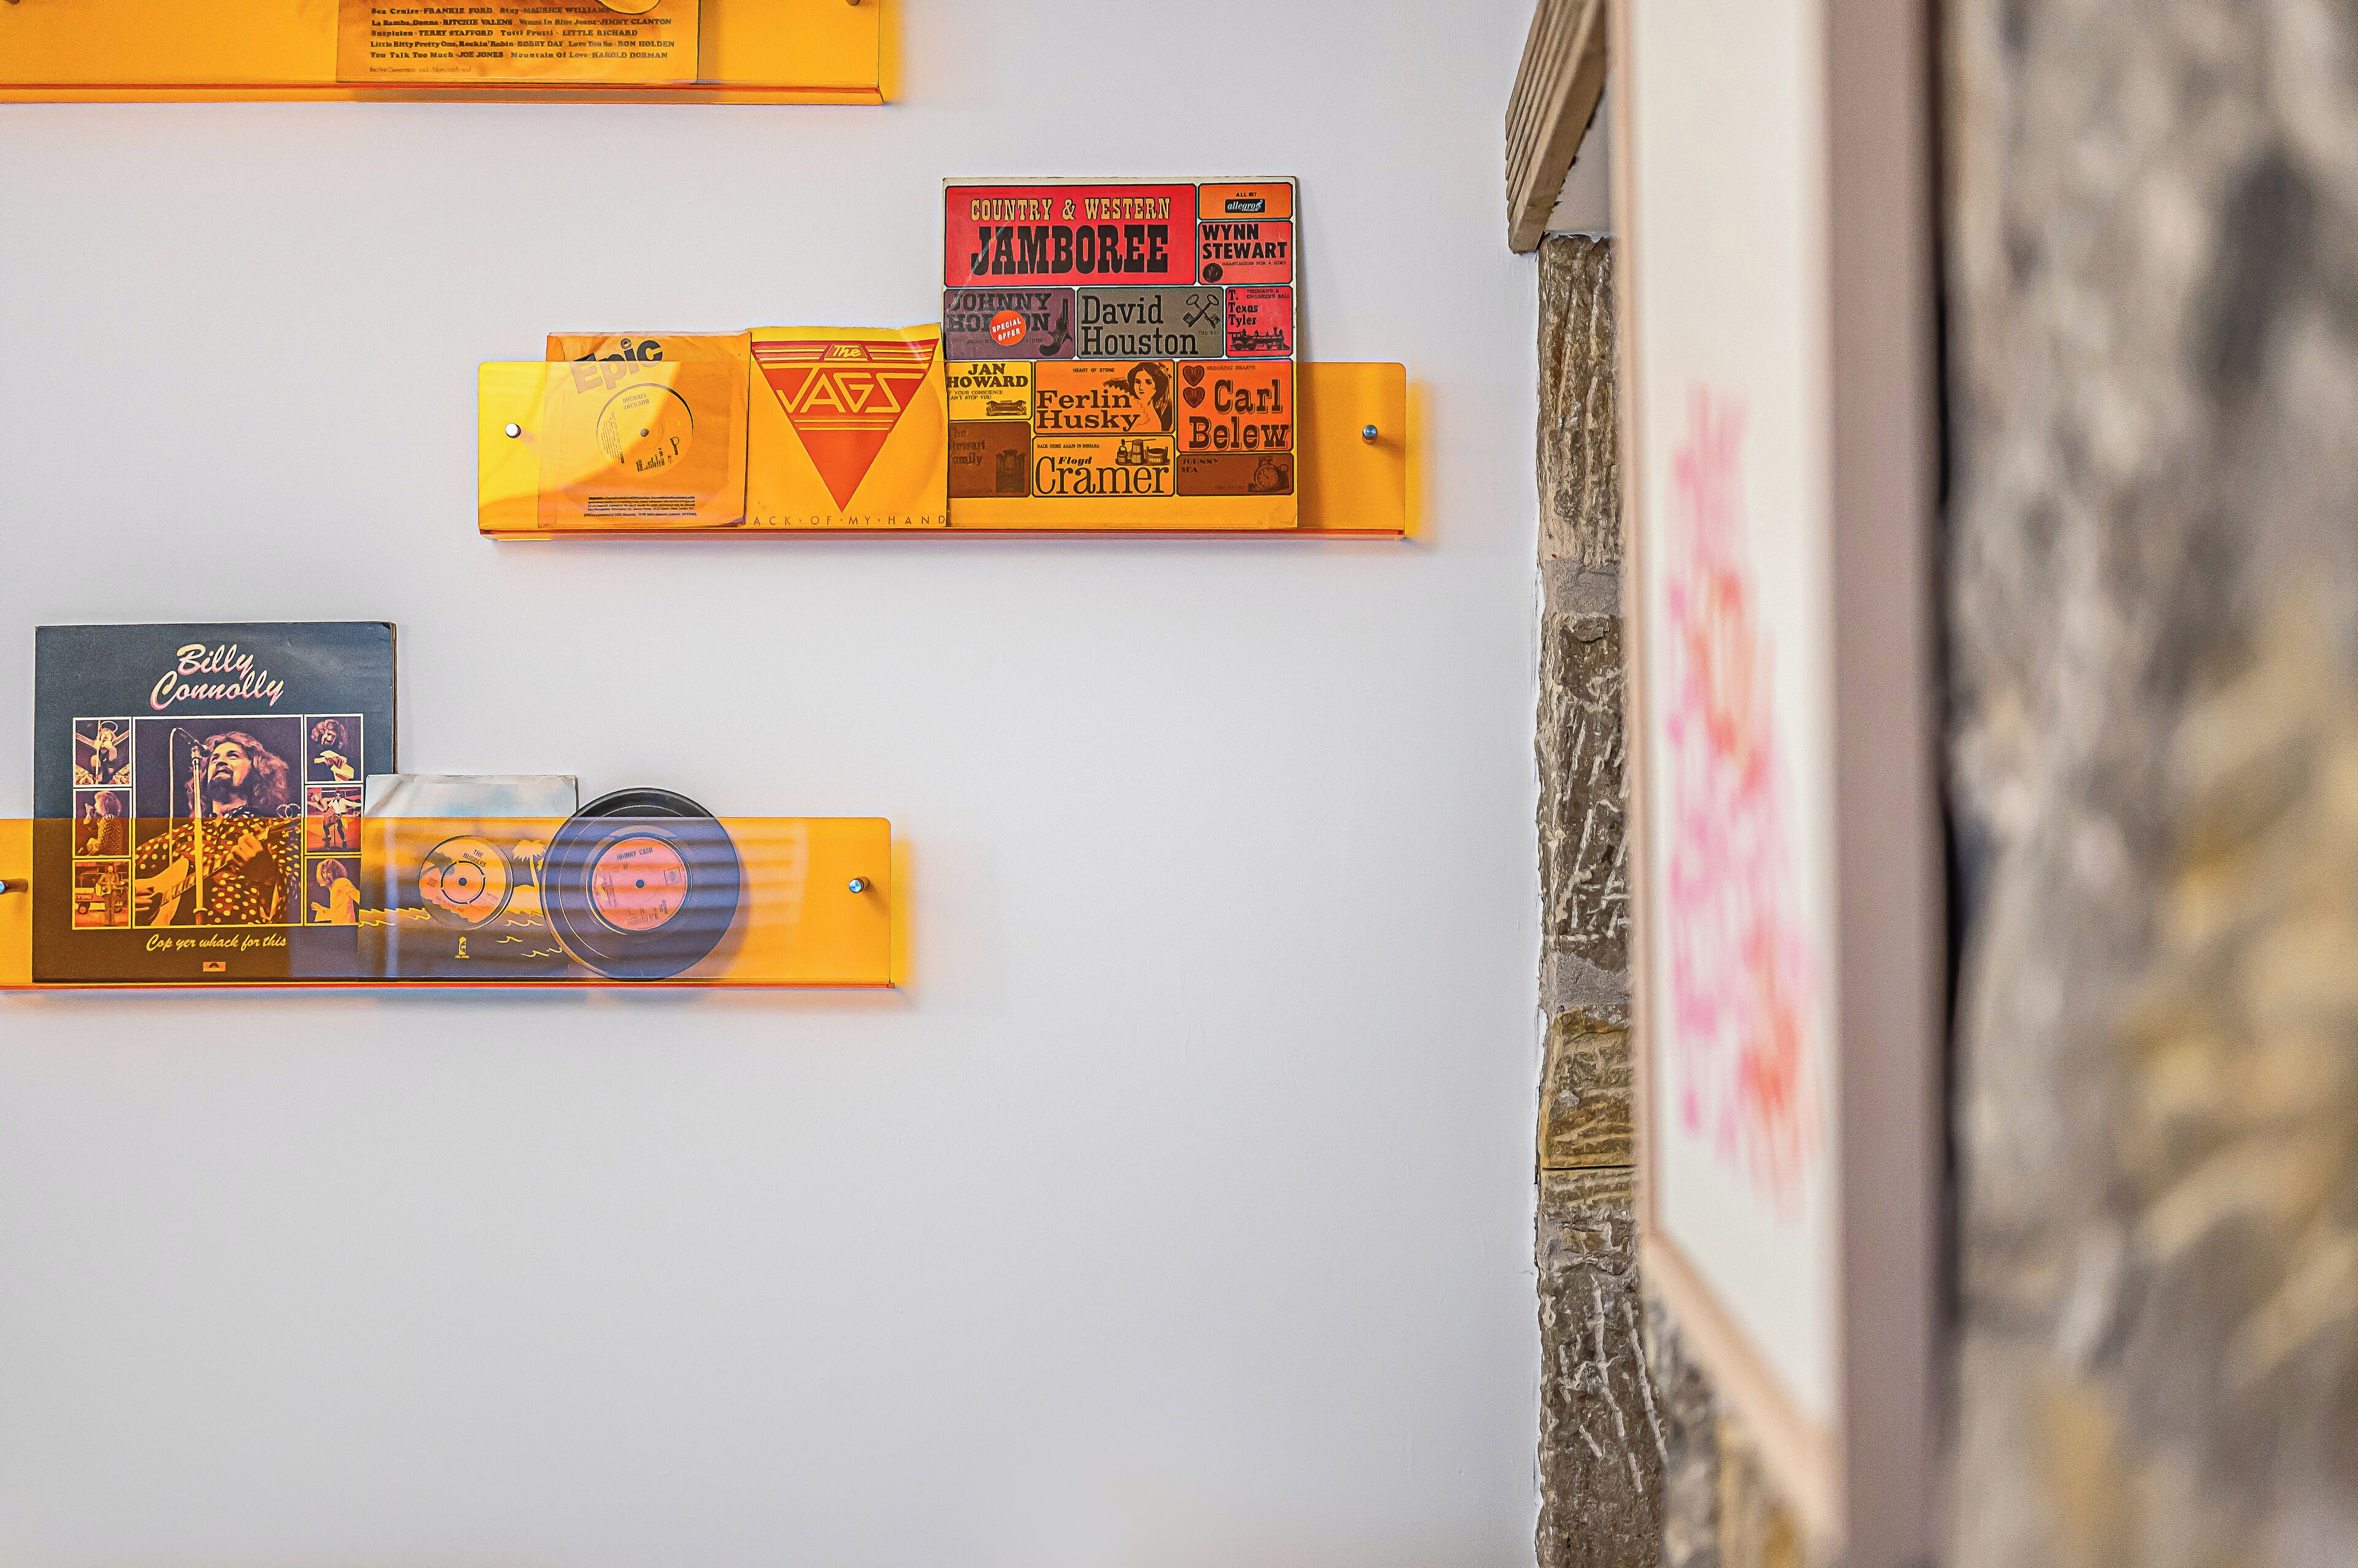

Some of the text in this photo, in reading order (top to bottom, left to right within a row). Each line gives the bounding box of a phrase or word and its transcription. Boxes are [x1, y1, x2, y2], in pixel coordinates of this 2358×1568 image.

[971, 197, 1171, 222] COUNTRY & WESTERN
[1227, 201, 1255, 211] allegro
[1202, 223, 1258, 241] WYNN
[971, 224, 1168, 276] JAMBOREE
[1202, 242, 1288, 260] STEWART
[949, 293, 1052, 311] JOHNNY
[1228, 290, 1239, 300] T.
[1081, 295, 1164, 325] David
[1228, 302, 1258, 313] Texas
[992, 317, 1021, 333] SPECIAL
[1228, 314, 1256, 327] Tyler
[998, 328, 1020, 341] OFFER
[1080, 326, 1200, 355] Houston
[832, 344, 862, 358] The
[569, 338, 663, 394] Epic
[968, 363, 1006, 375] JAN
[776, 368, 924, 413] JAGS
[947, 376, 1029, 388] HOWARD
[623, 393, 647, 403] MICHAEL
[623, 399, 650, 410] JACKSON
[1037, 389, 1132, 409] Ferlin
[1213, 379, 1283, 414] Carl
[1037, 410, 1141, 432] Husky
[1189, 416, 1290, 451] Belew
[1057, 456, 1092, 467] Floyd
[1035, 456, 1169, 495] Cramer
[753, 514, 945, 526] ACK OF MY HAND
[176, 643, 254, 678] Billy
[149, 670, 284, 710] Connolly
[462, 852, 486, 868] BUGGLES
[473, 849, 484, 858] THE
[617, 850, 636, 860] JOHNNY
[146, 933, 287, 951] Cop yer whack for this
